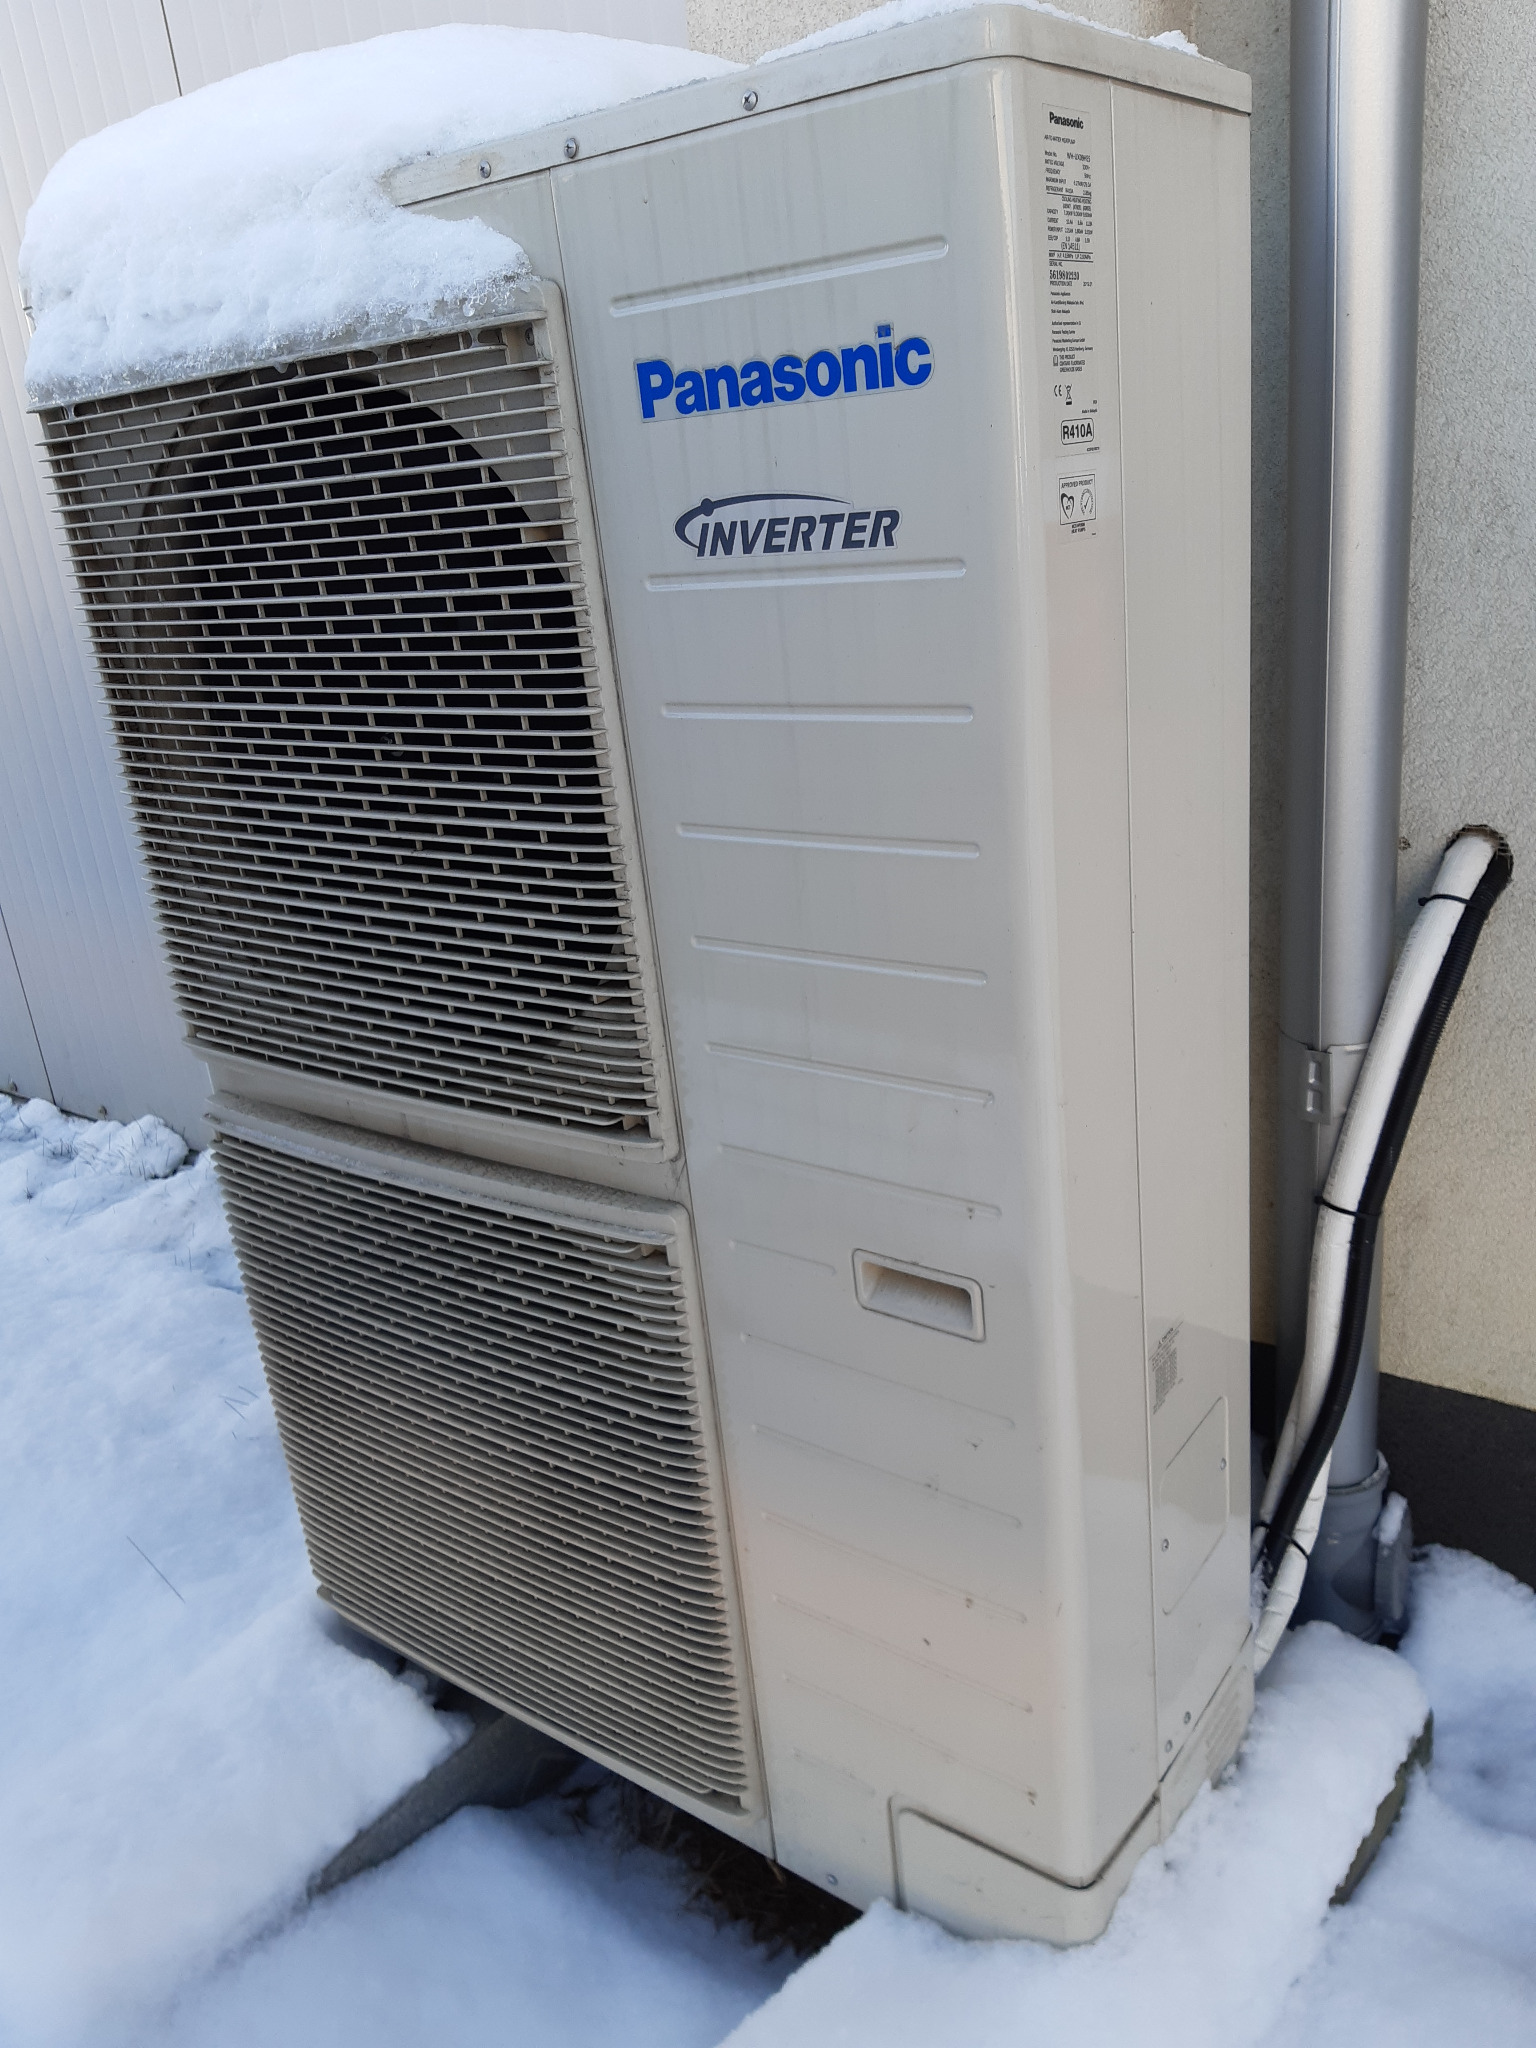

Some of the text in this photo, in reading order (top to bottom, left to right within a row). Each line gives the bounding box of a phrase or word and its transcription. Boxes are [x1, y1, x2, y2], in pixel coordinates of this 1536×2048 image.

[1049, 111, 1084, 130] Panasonic
[636, 324, 932, 419] Panasonic
[1062, 422, 1093, 440] R410A
[694, 506, 901, 558] INVERTER
